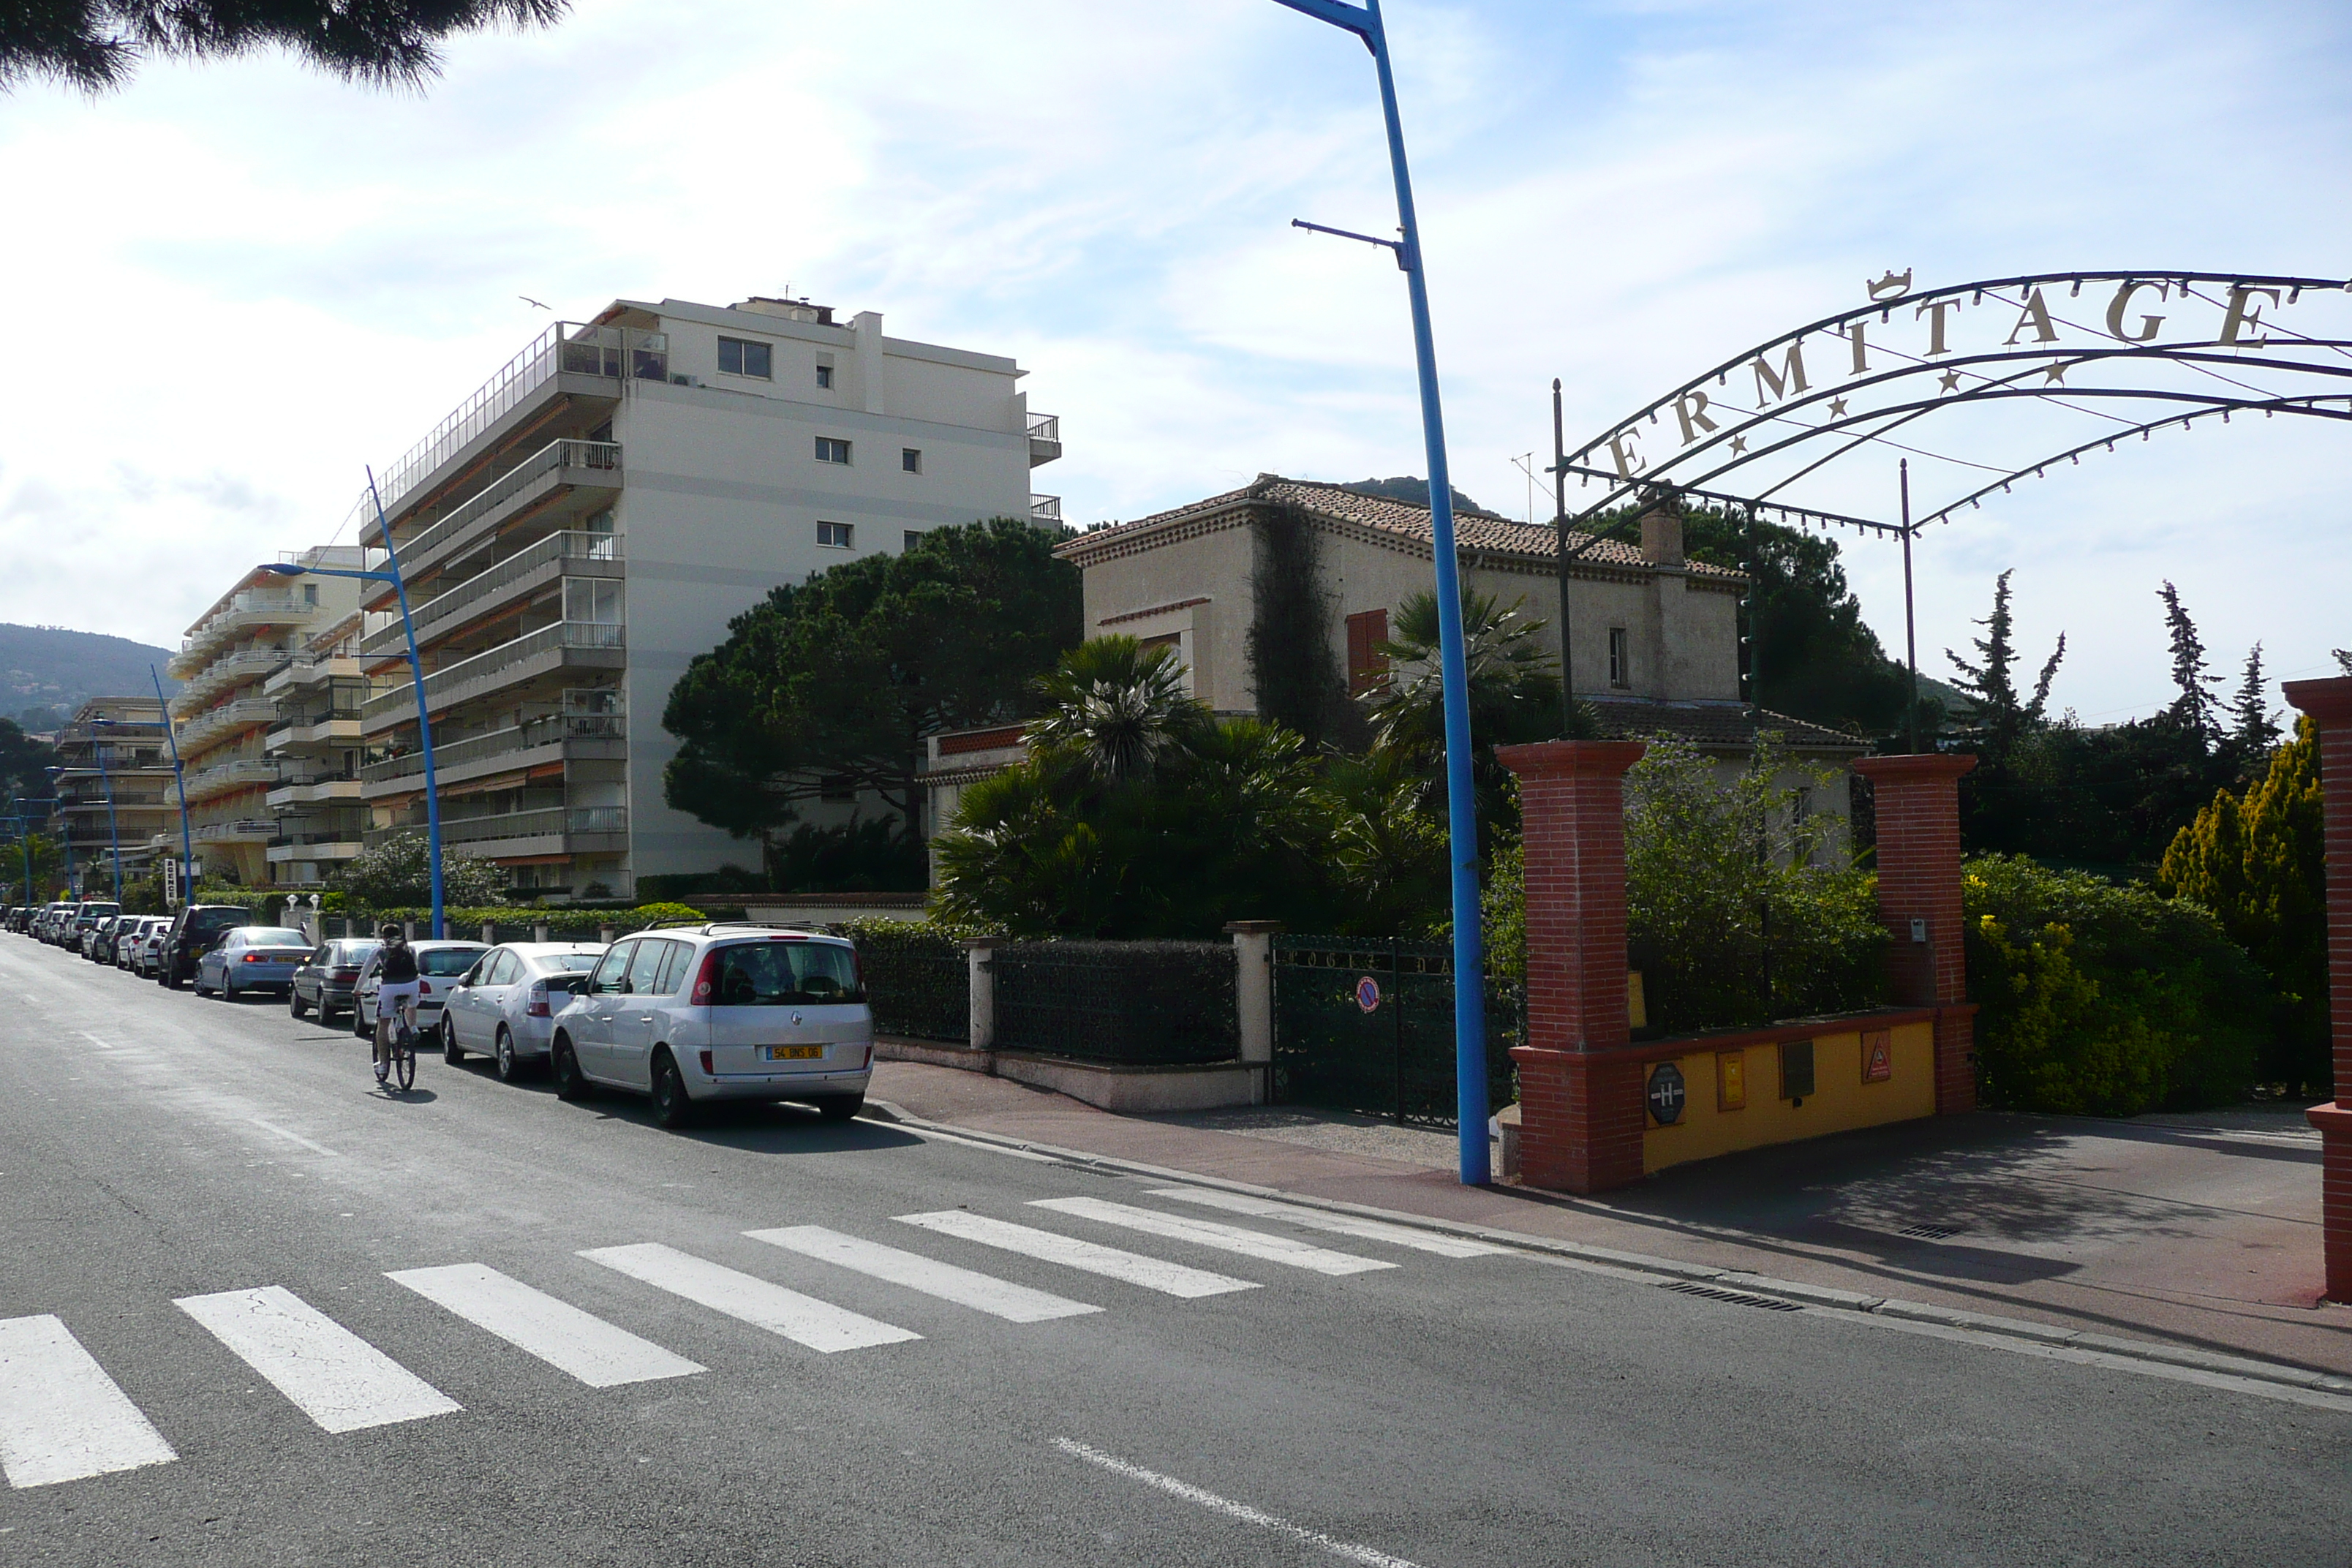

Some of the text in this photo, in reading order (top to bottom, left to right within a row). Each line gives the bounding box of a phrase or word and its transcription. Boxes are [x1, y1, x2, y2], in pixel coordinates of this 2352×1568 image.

[1605, 280, 2280, 481] ERMITAGE
[774, 1048, 785, 1058] 54
[808, 1047, 819, 1058] 06
[1660, 1082, 1673, 1107] H
